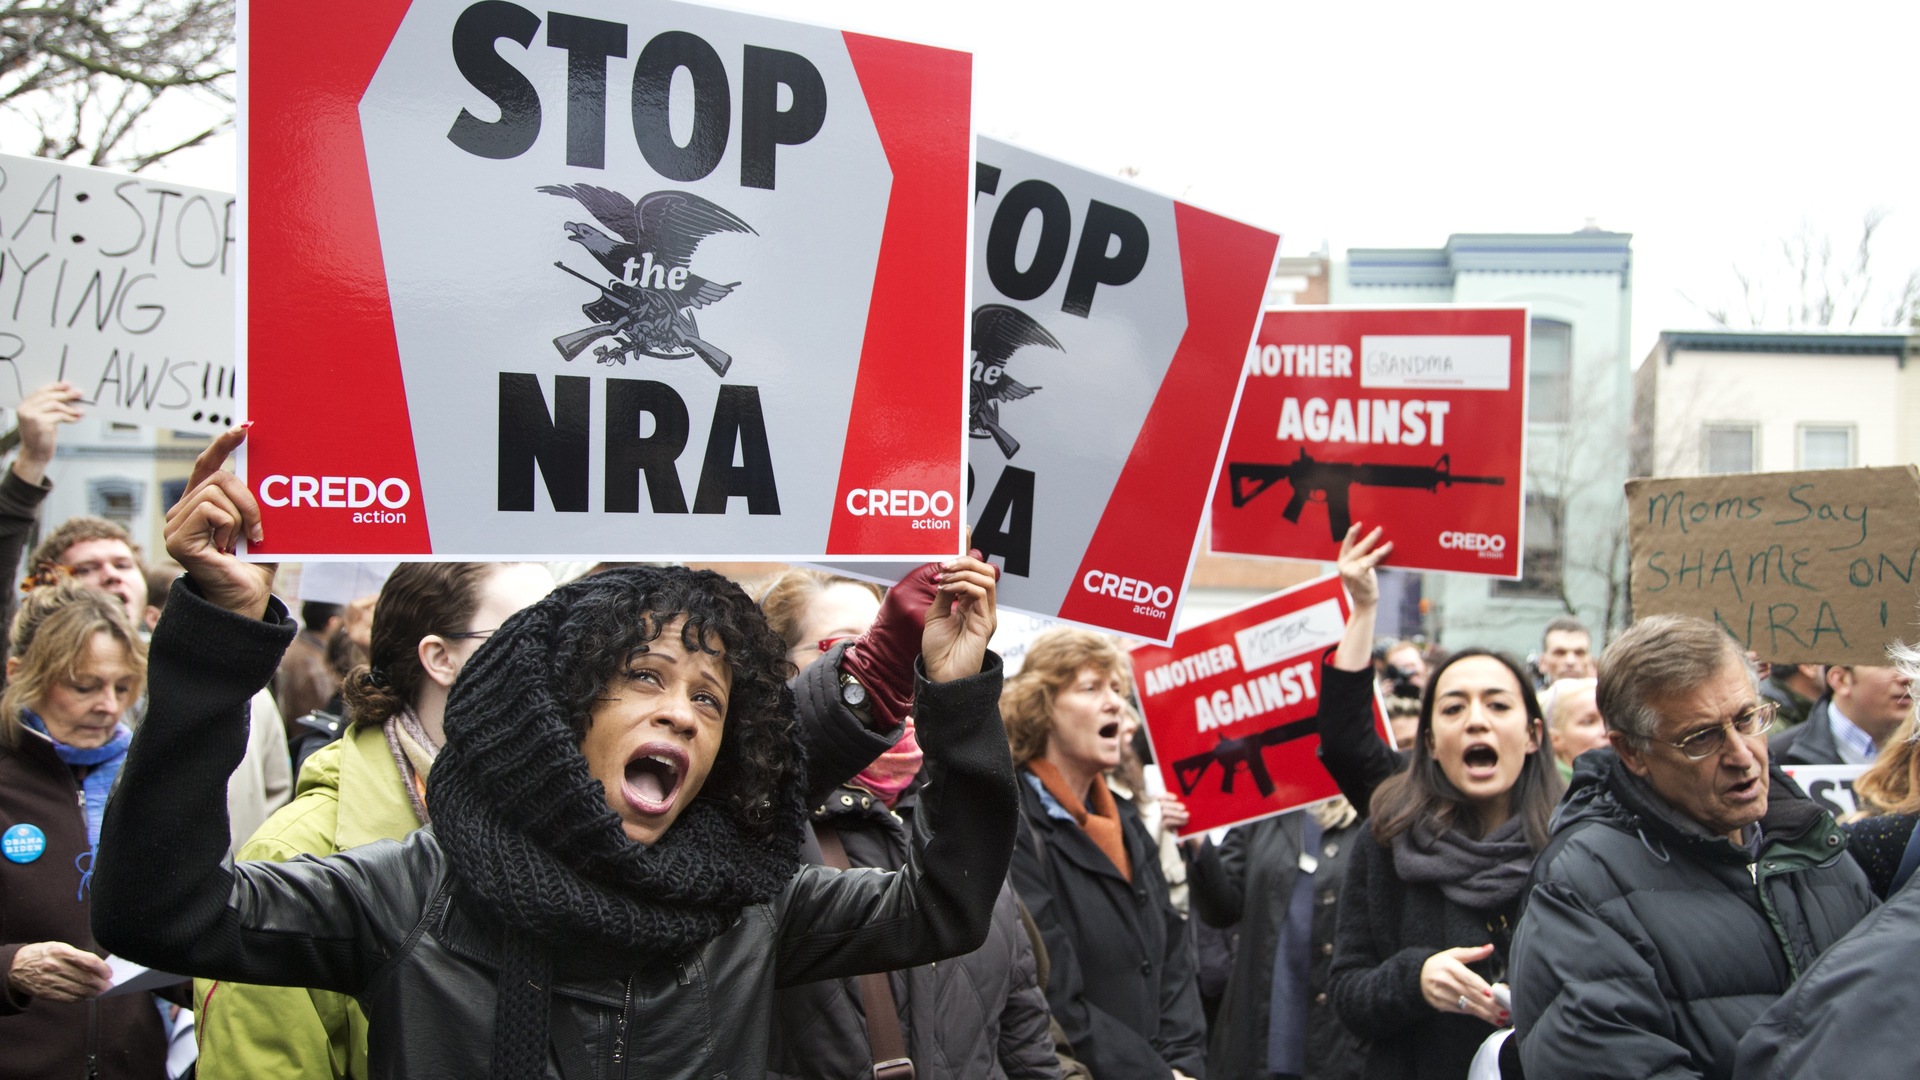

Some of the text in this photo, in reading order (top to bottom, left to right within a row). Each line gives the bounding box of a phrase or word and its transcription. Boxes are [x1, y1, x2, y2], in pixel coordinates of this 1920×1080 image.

[447, 0, 827, 190] STOP
[975, 161, 1150, 320] OP
[0, 246, 166, 335] YING
[622, 252, 689, 291] the
[1366, 351, 1454, 376] GRANDMA
[498, 371, 781, 515] NRA
[1276, 397, 1450, 446] AGAINST
[259, 474, 411, 509] CREDO
[846, 488, 954, 517] CREDO
[352, 510, 407, 524] action
[911, 518, 951, 529] action
[1774, 484, 1868, 551] Say
[1438, 530, 1506, 551] CREDO
[1083, 569, 1174, 608] CREDO
[1646, 544, 1920, 603] SHAME ON
[1132, 604, 1167, 619] action
[1144, 643, 1238, 697] ANOTHER
[1194, 660, 1317, 733] AGAINST
